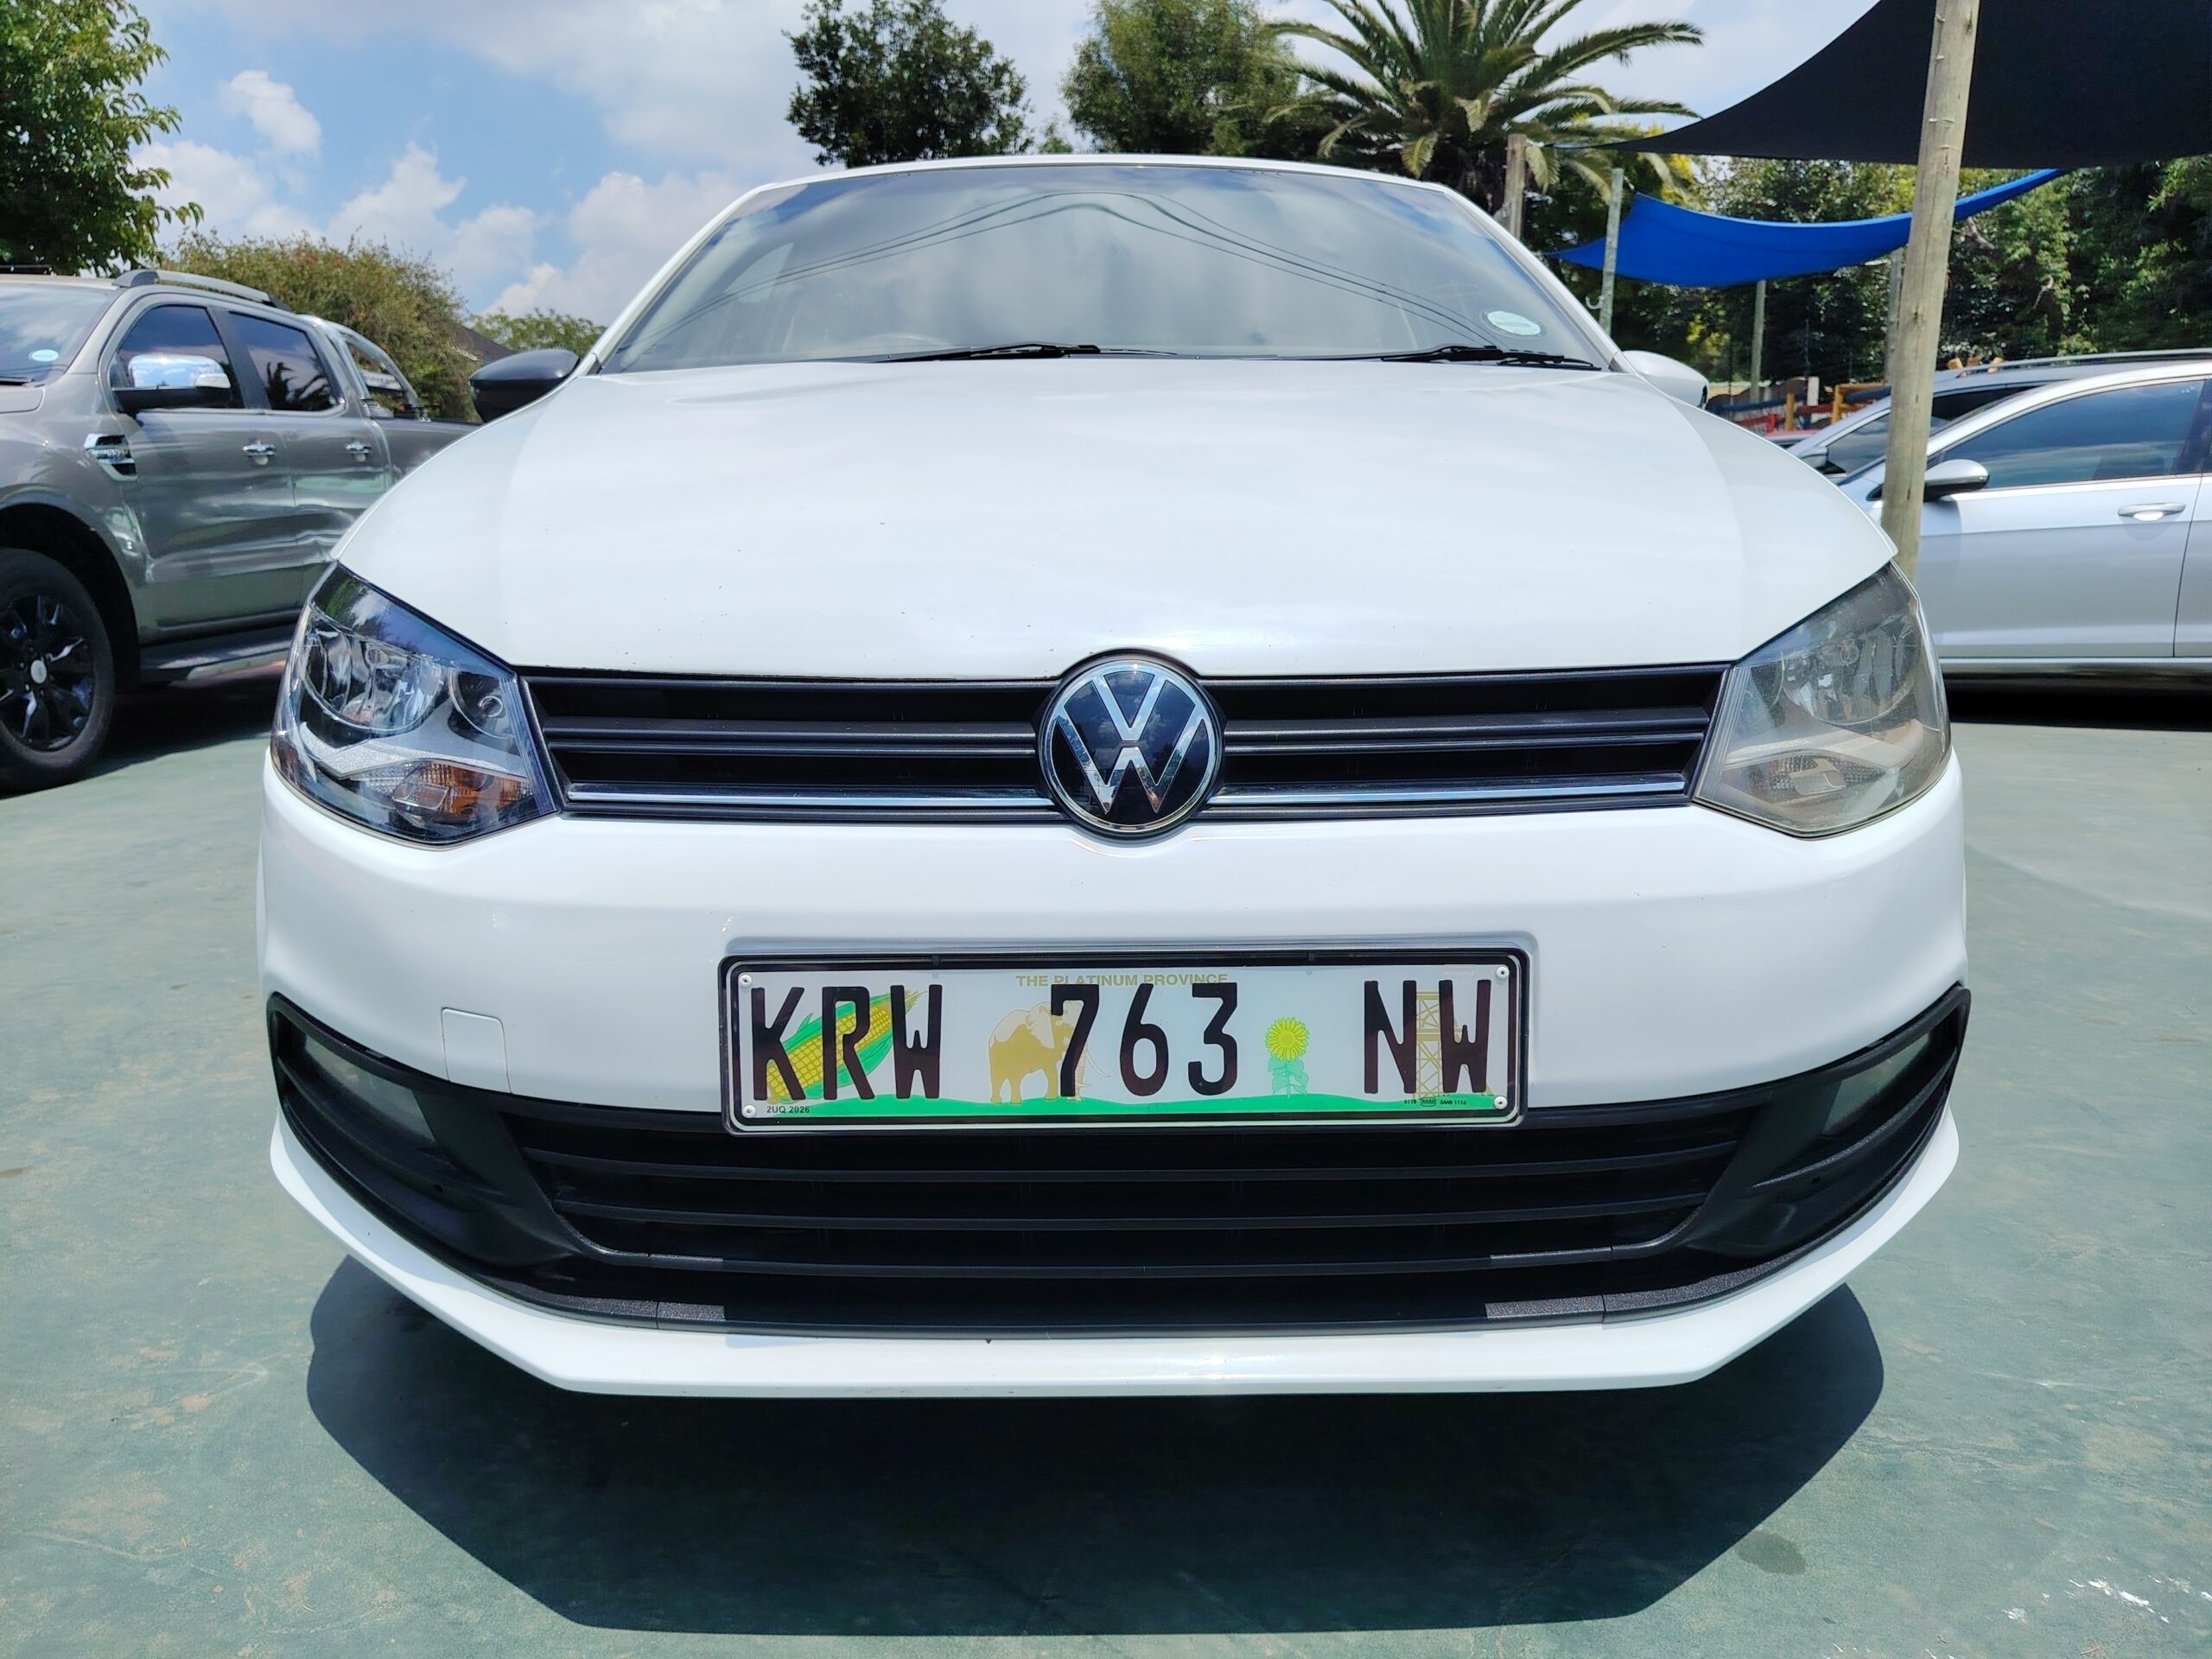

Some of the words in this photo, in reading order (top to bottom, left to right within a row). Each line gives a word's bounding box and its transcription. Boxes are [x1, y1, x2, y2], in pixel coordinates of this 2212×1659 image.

[1047, 664, 1211, 815] VW
[751, 984, 943, 1101] KRW
[1051, 982, 1238, 1097] 763
[1363, 979, 1491, 1094] NW
[1016, 975, 1048, 987] THE
[1053, 974, 1138, 987] PLATINUM
[1143, 973, 1228, 986] PROVINCE
